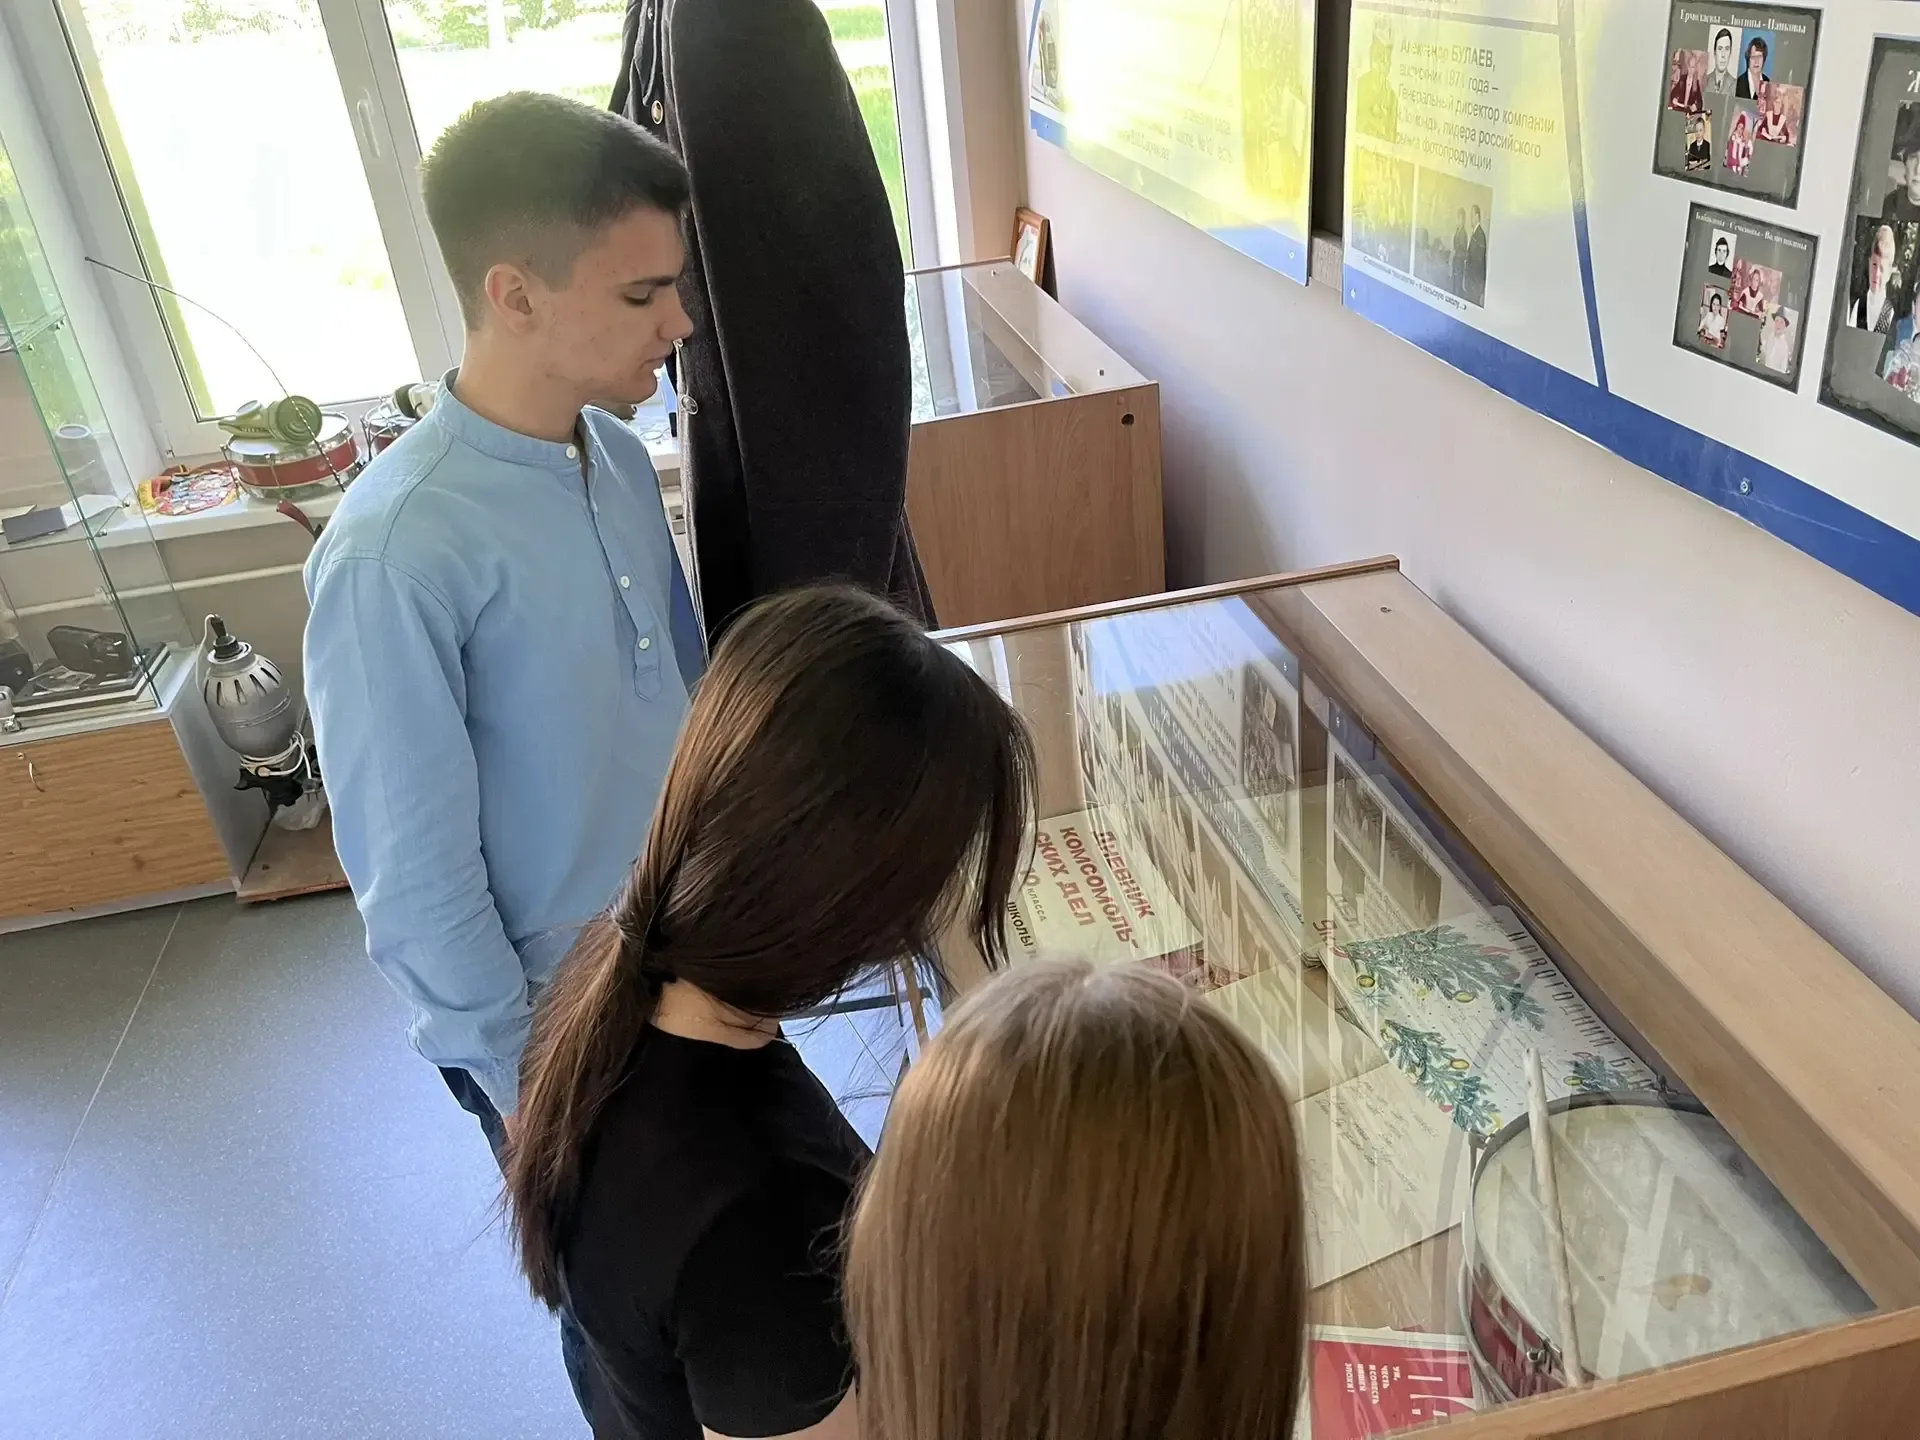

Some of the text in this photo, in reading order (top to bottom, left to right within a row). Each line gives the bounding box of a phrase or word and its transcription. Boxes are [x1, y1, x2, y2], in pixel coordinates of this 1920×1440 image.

[1451, 44, 1496, 72] БУЛАЕВ,
[1468, 77, 1490, 96] года
[1455, 99, 1500, 126] директор
[1502, 108, 1556, 134] компании
[1422, 137, 1493, 172] фотопродукции
[1443, 120, 1477, 144] лидера
[1478, 128, 1542, 159] российского
[1027, 897, 1048, 923] КЛАССА
[1056, 881, 1096, 926] ДЕЛ
[1006, 901, 1035, 947] ШКОЛЫ
[1380, 1366, 1390, 1388] ЧЕСТЬ
